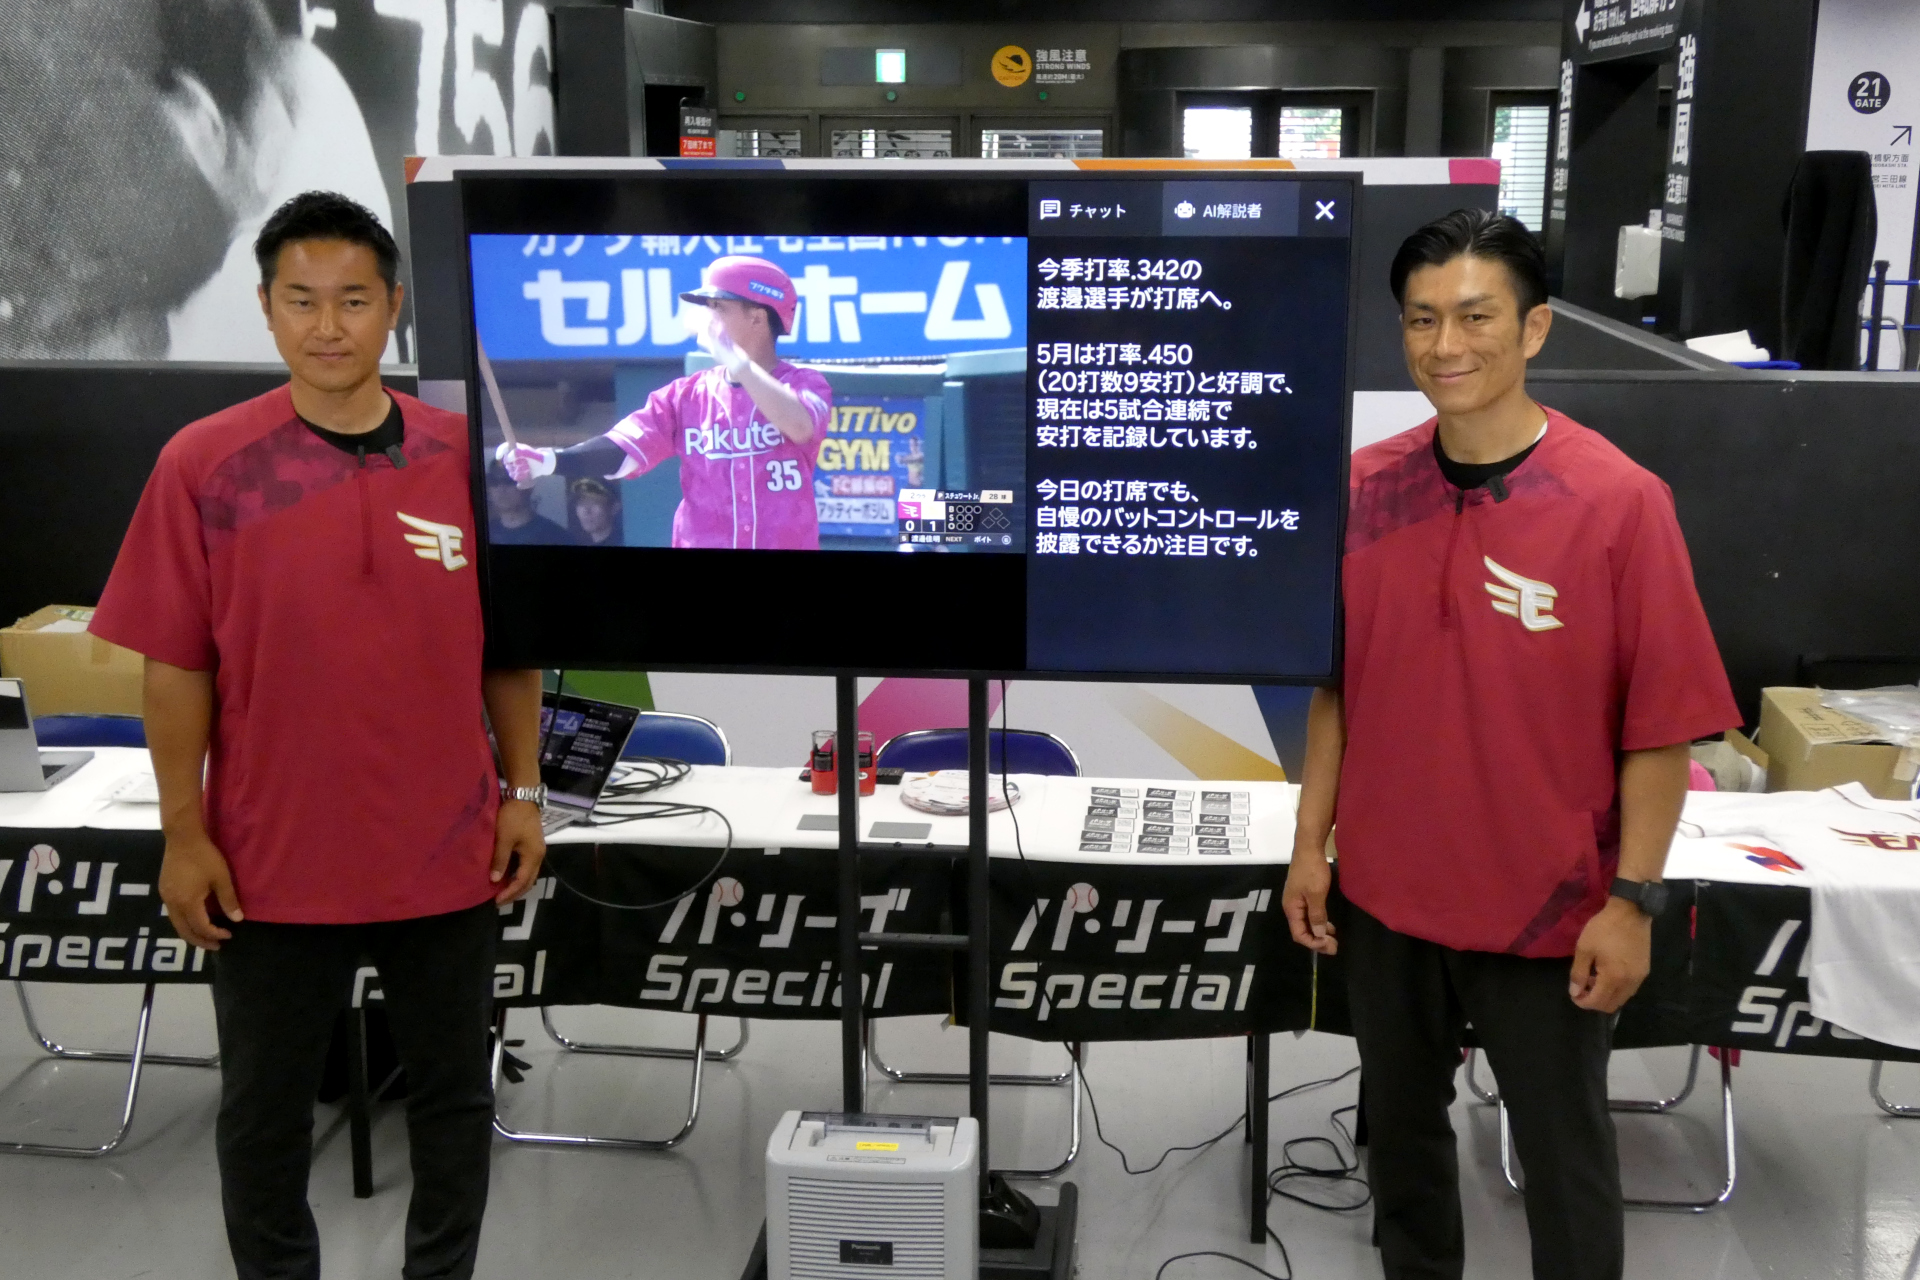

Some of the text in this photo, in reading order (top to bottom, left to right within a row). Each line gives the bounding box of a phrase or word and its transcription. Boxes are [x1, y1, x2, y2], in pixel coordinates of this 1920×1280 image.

[1036, 49, 1087, 62] 強風注意
[1856, 77, 1881, 97] 21
[1854, 98, 1882, 108] GATE
[1069, 203, 1127, 219] チャット
[1202, 202, 1263, 219] AI解説者
[1037, 258, 1203, 281] 今季打率.342の
[522, 261, 1012, 346] セルホーム
[1037, 285, 1233, 311] 渡邊選手が打席へ。
[1037, 343, 1194, 366] 5月は打率.450
[1037, 370, 1294, 395] (20打数9安打)と好調で、
[1036, 398, 1233, 421] 現在は5試合連続で
[684, 420, 785, 457] Rakute
[1036, 425, 1258, 450] 安打を記録しています。
[816, 437, 891, 472] GYM
[765, 459, 803, 492] 35
[1036, 479, 1200, 503] 今日の打席でも、
[948, 505, 955, 513] B
[948, 514, 955, 522] S
[1036, 505, 1300, 531] 自慢のバットコントロールを
[905, 520, 915, 531] 0
[929, 520, 936, 532] 1
[974, 535, 992, 543] ボイト
[1036, 532, 1259, 557] 披露できるか注目です。
[0, 843, 169, 917] パ・リー
[1010, 882, 1272, 954] パ・リーグ
[994, 961, 1256, 1022] Special
